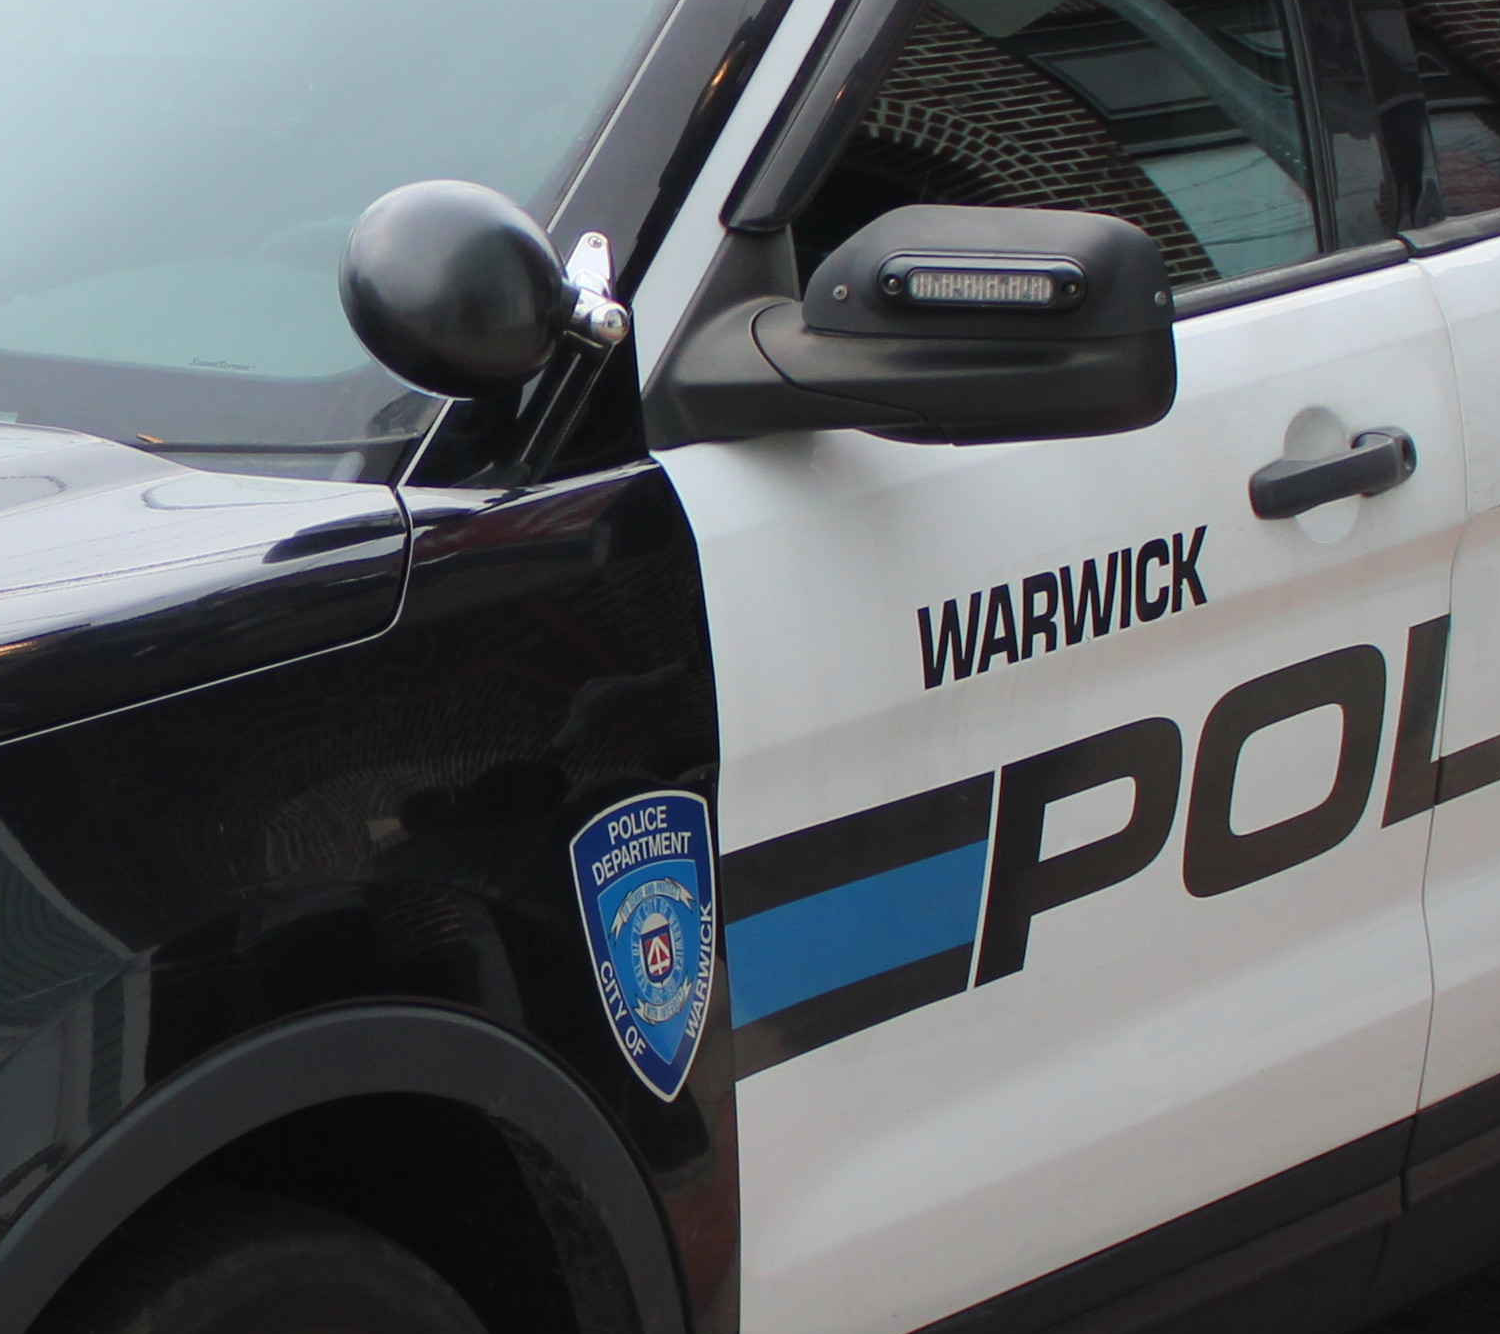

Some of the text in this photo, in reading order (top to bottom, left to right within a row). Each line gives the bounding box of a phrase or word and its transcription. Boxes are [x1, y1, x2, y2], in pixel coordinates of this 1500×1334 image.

[917, 524, 1208, 691] WARWICK
[591, 831, 692, 887] DEPARTMENT
[607, 805, 668, 846] POLICE
[600, 960, 628, 1022] CITY
[625, 1025, 646, 1056] OF
[685, 900, 713, 1040] WARWICK
